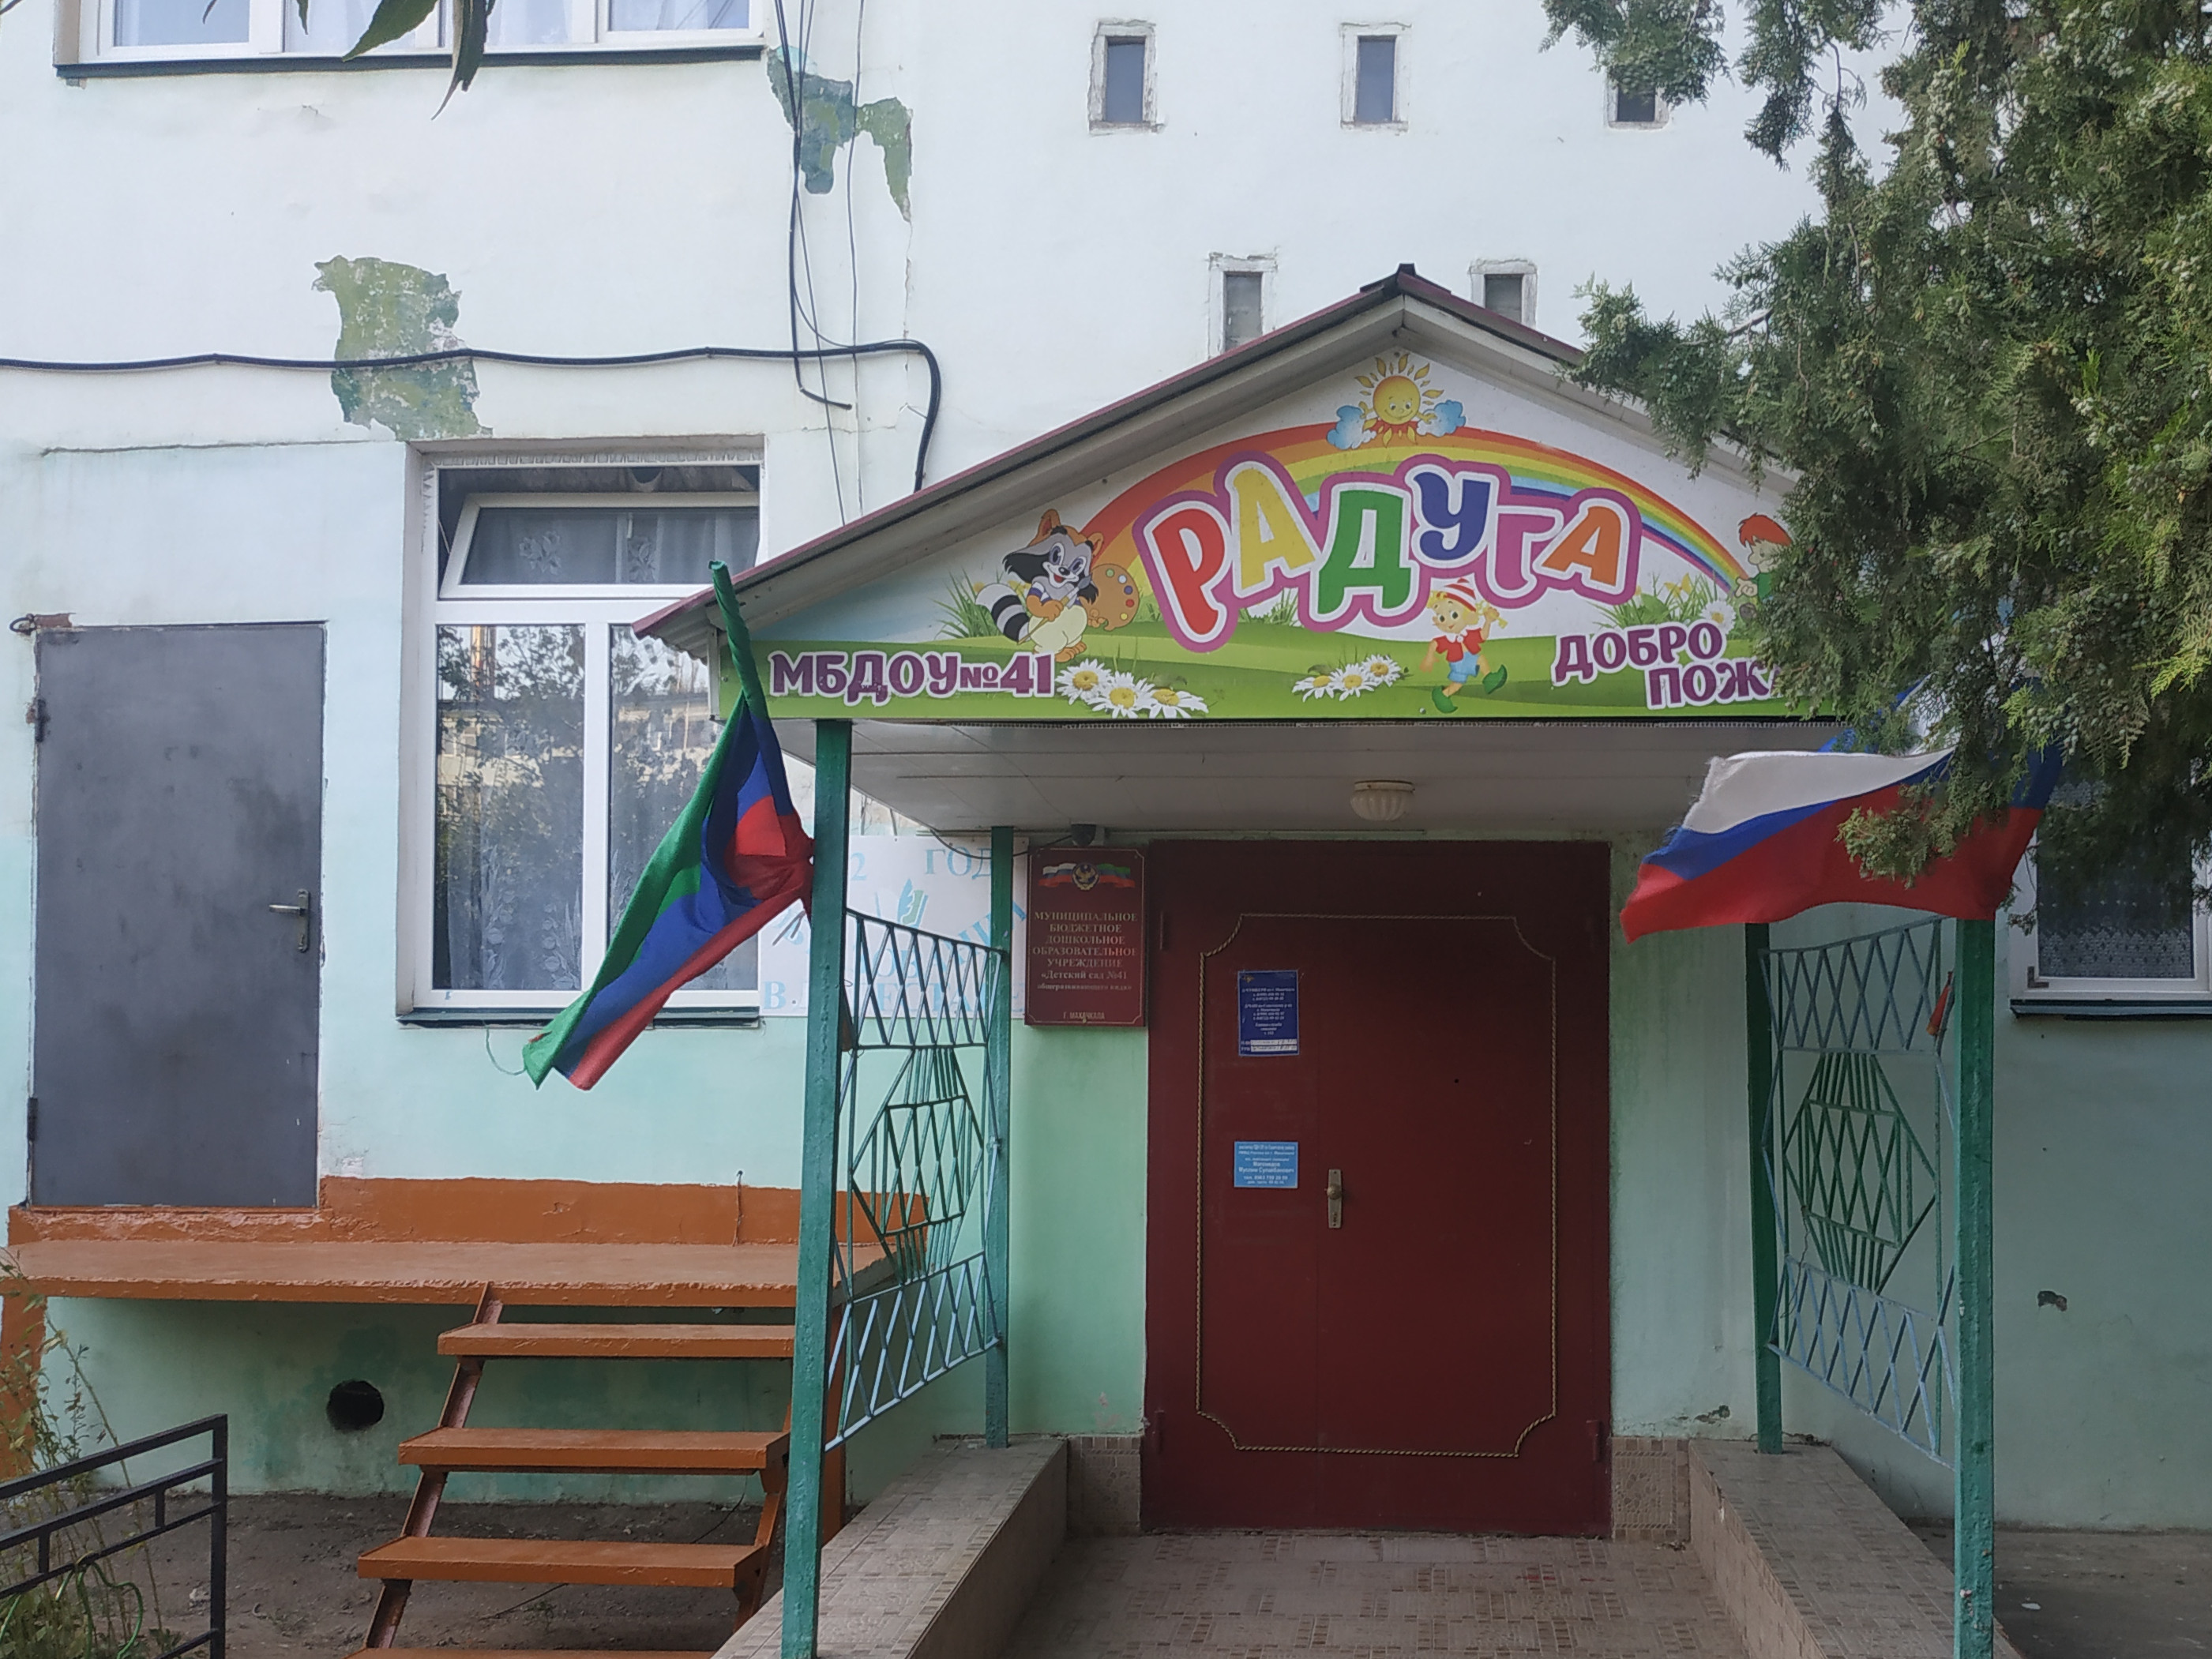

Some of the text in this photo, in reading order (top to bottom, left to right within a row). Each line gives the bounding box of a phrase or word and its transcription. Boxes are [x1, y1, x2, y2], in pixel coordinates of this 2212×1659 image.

[1141, 456, 1632, 644] РАДУГА
[1553, 621, 1723, 684] ДОБРО
[1648, 660, 1783, 708] ПОЖ
[1035, 911, 1137, 922] МУНИЦИПАЛЬНОЕ
[1050, 923, 1122, 933] БЮДЖЕТНОЕ
[1046, 935, 1125, 945] ДОШКОЛЬНОЕ
[1032, 947, 1137, 957] ОБРАЗОВАТЕЛЬНОЕ
[1046, 958, 1123, 968] УЧРЕЖДЕНИЕ
